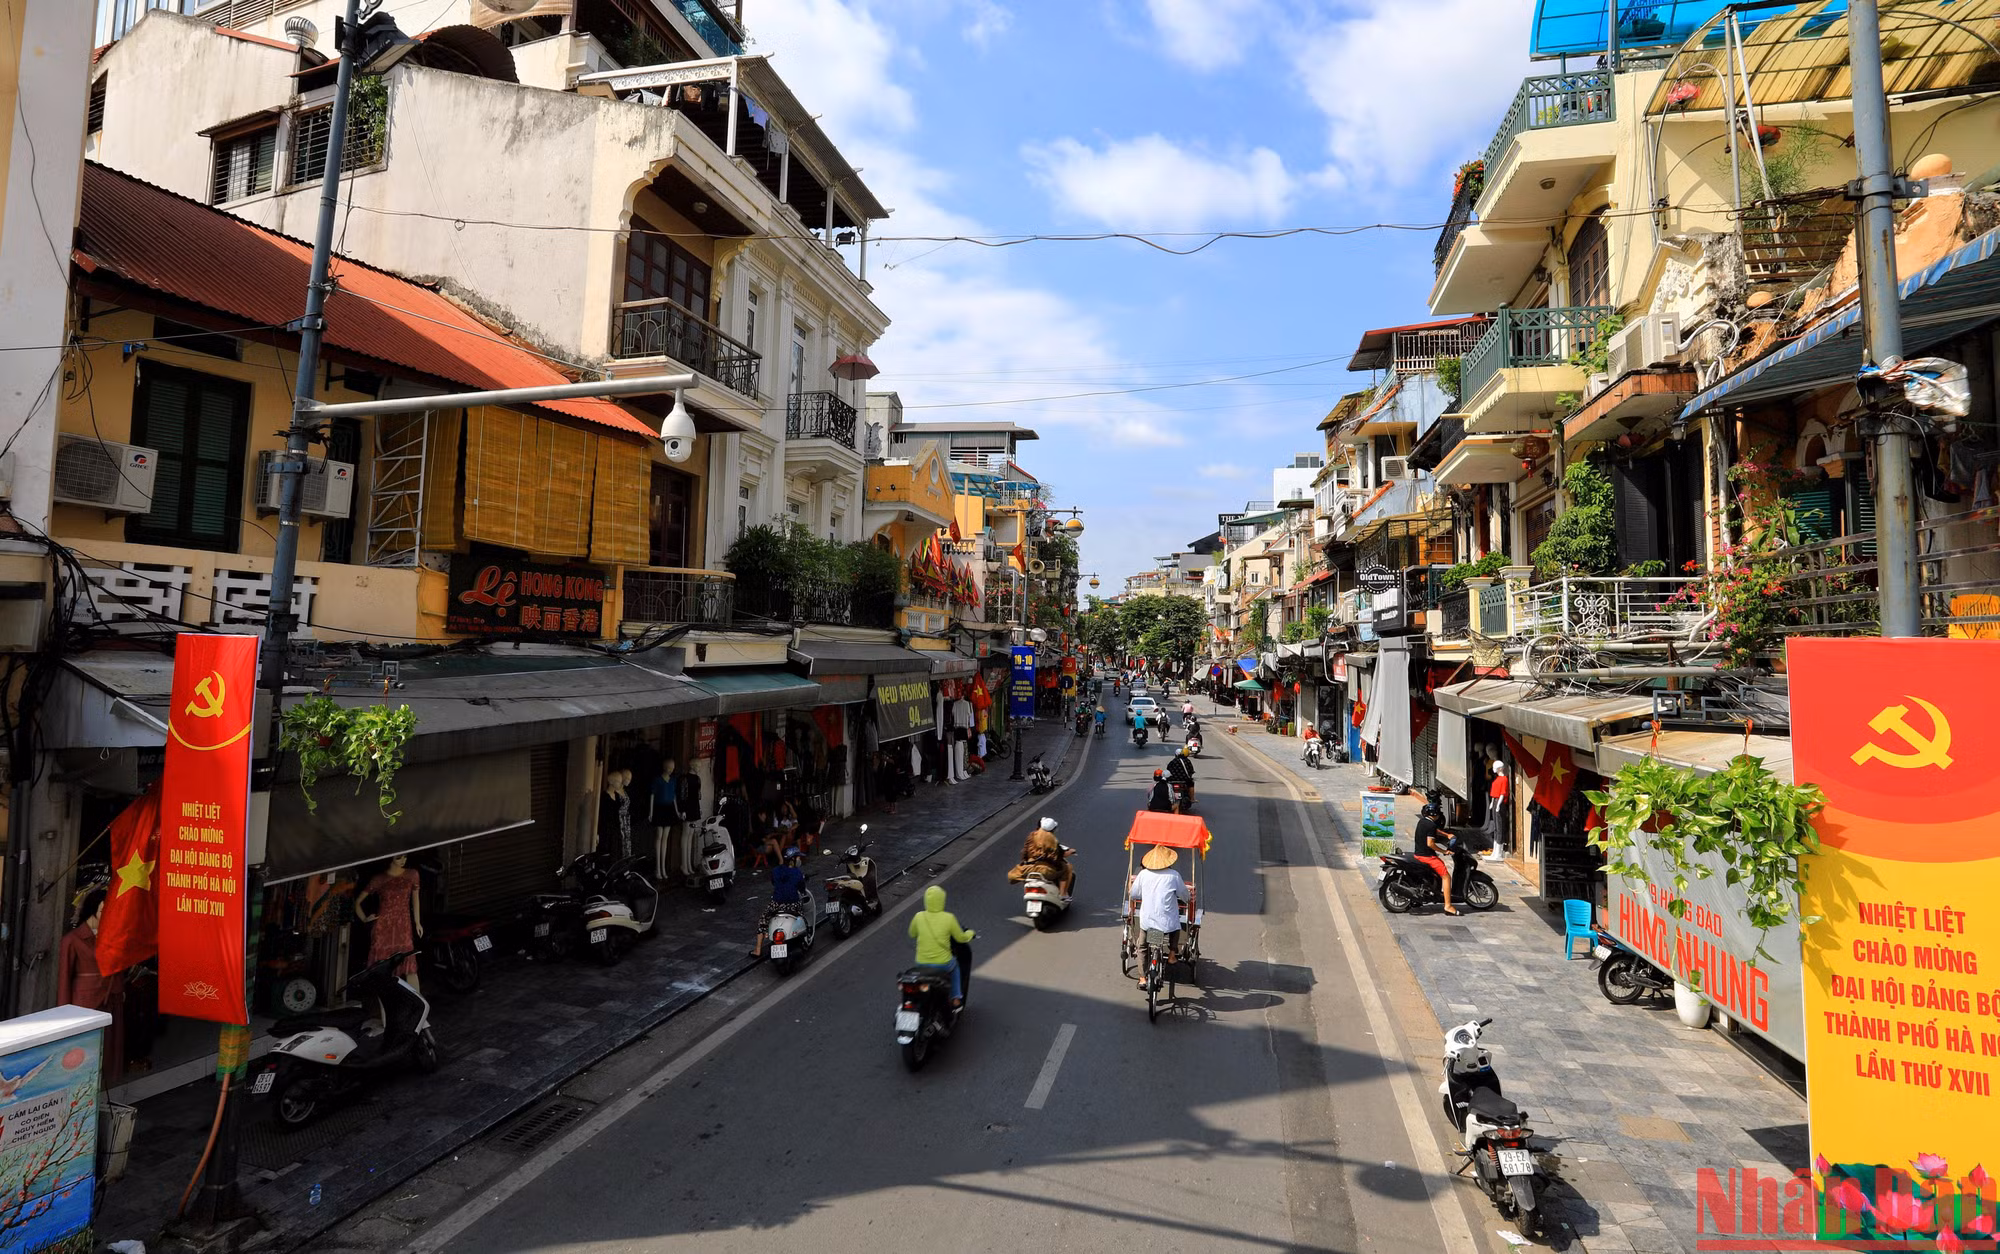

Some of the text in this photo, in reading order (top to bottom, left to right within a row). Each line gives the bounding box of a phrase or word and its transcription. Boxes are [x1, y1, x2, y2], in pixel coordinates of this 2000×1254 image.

[520, 570, 604, 602] HONG KONG
[521, 604, 600, 633] 映丽香港
[899, 681, 929, 702] FASHION
[908, 706, 921, 728] 94
[182, 800, 221, 822] NHIỆT LIỆT
[179, 823, 224, 844] CHÀO MỪNG
[170, 847, 233, 872] ĐẠI HỘI ĐẢNG BỘ
[166, 870, 236, 897] THÀNH PHỐ HÀ NỘI
[177, 892, 225, 917] LẦN THỨ XVII
[1695, 903, 1723, 938] ĐÀO
[1858, 901, 1966, 938] NHIỆT LIỆT
[1619, 891, 1769, 1032] HÙNG NHUNG
[1853, 937, 1978, 975] CHÀO MỪNG
[1831, 974, 1865, 1004] ĐẠI
[1871, 976, 1905, 1009] HỘI
[1911, 978, 1970, 1014] ĐẢNG
[1823, 1010, 1891, 1043] THÀNH
[1897, 1017, 1939, 1049] PHỐ
[1945, 1025, 1975, 1054] HÀ
[1855, 1048, 1990, 1097] LẦN THỨ XVII
[8, 1108, 26, 1121] CẤM
[28, 1103, 40, 1115] LẠI
[14, 1123, 36, 1135] NGUY
[1503, 1152, 1526, 1163] 29-E2
[1503, 1163, 1532, 1174] 581.78
